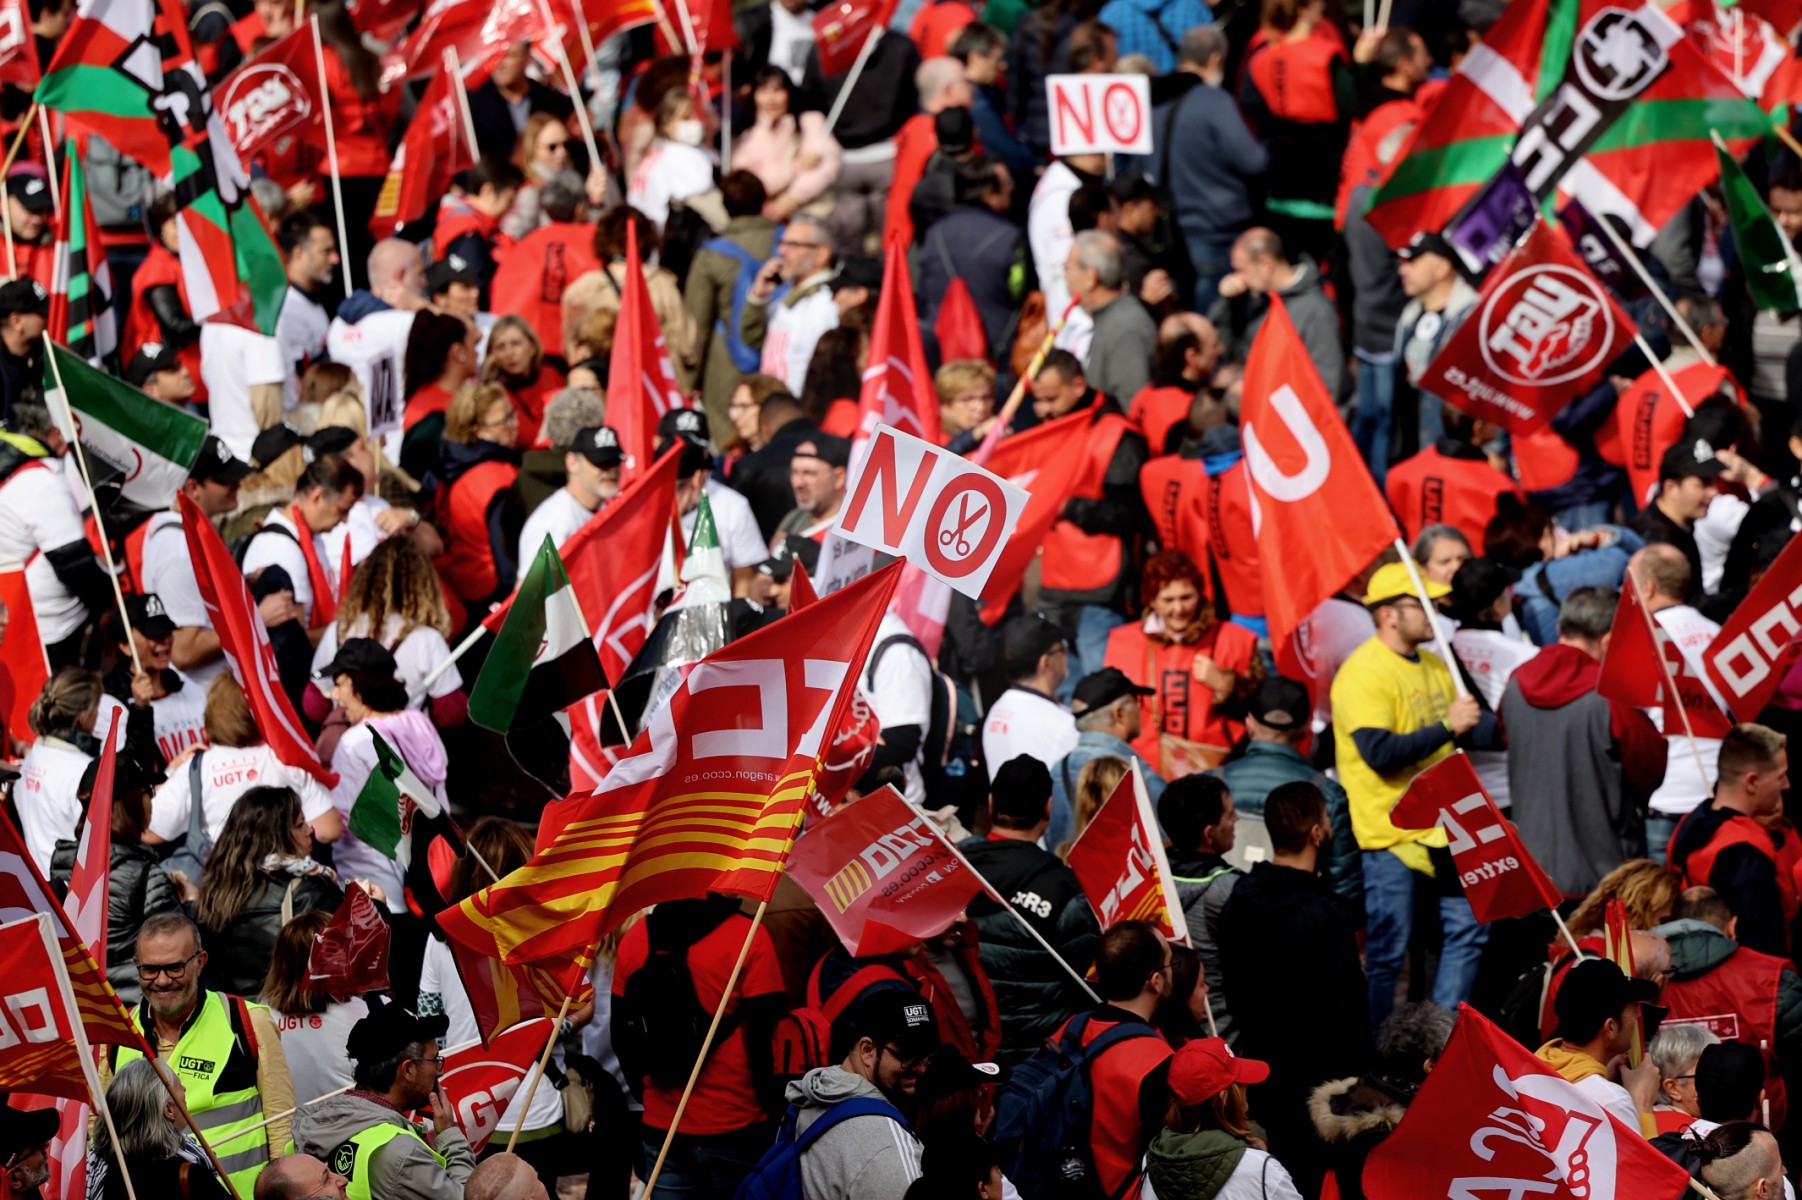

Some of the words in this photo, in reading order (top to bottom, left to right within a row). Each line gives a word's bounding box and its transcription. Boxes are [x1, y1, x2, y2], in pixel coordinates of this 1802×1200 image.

[1055, 83, 1141, 145] NO
[841, 431, 1007, 578] NO
[213, 771, 243, 788] UGT
[905, 1005, 923, 1017] UGT
[278, 1015, 305, 1031] UGT
[180, 1058, 204, 1070] UGT
[192, 1072, 210, 1081] FICA
